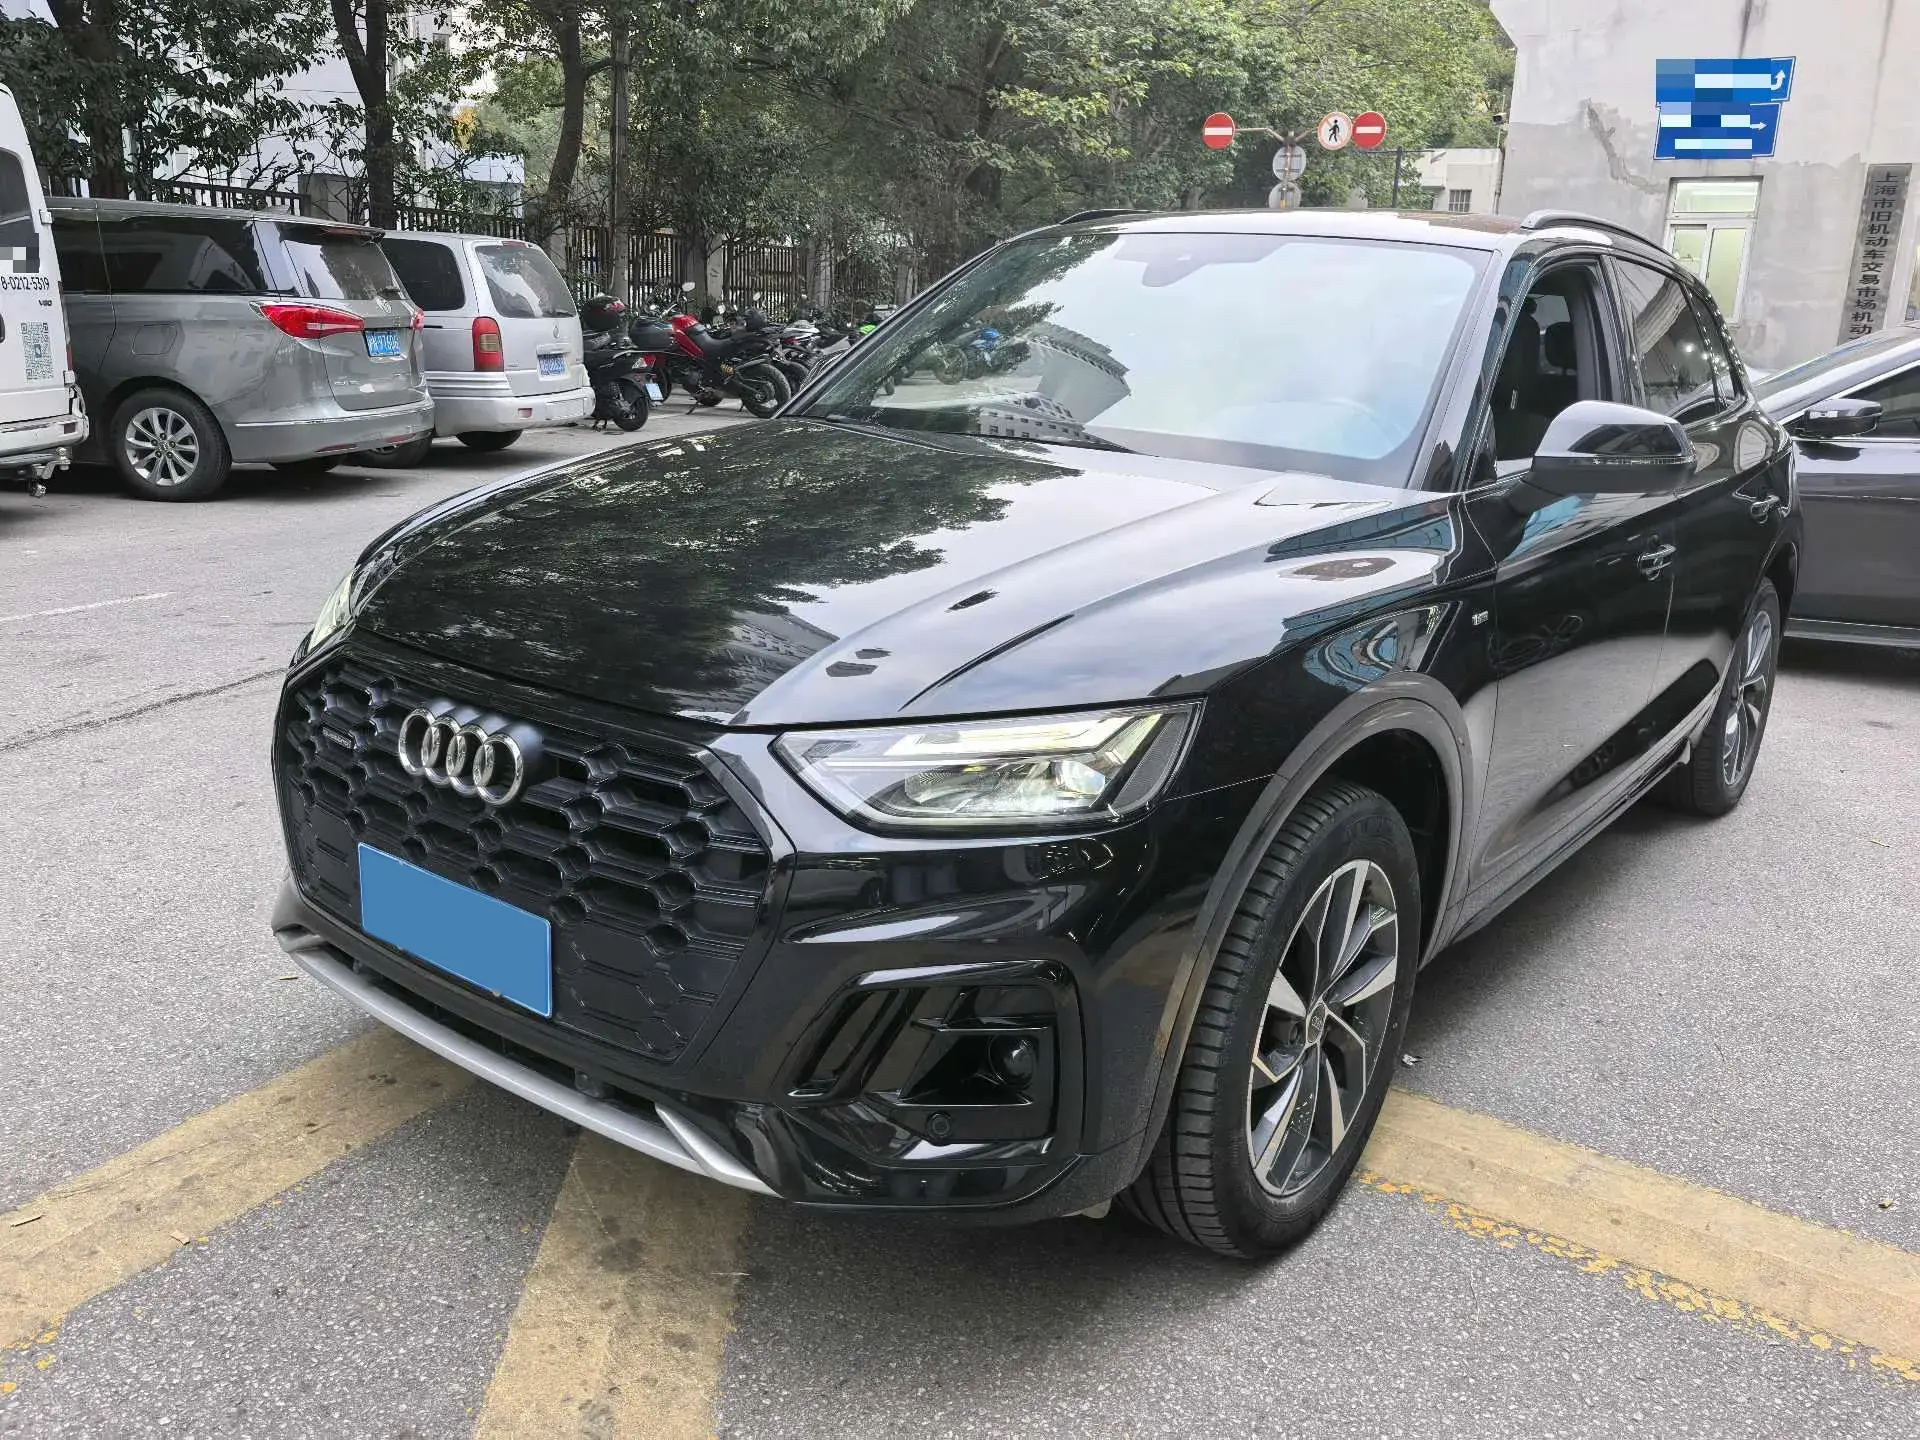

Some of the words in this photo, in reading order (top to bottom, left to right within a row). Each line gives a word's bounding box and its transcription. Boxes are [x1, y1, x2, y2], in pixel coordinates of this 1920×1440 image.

[1848, 171, 1898, 341] 上海市旧机动车交易市场机动
